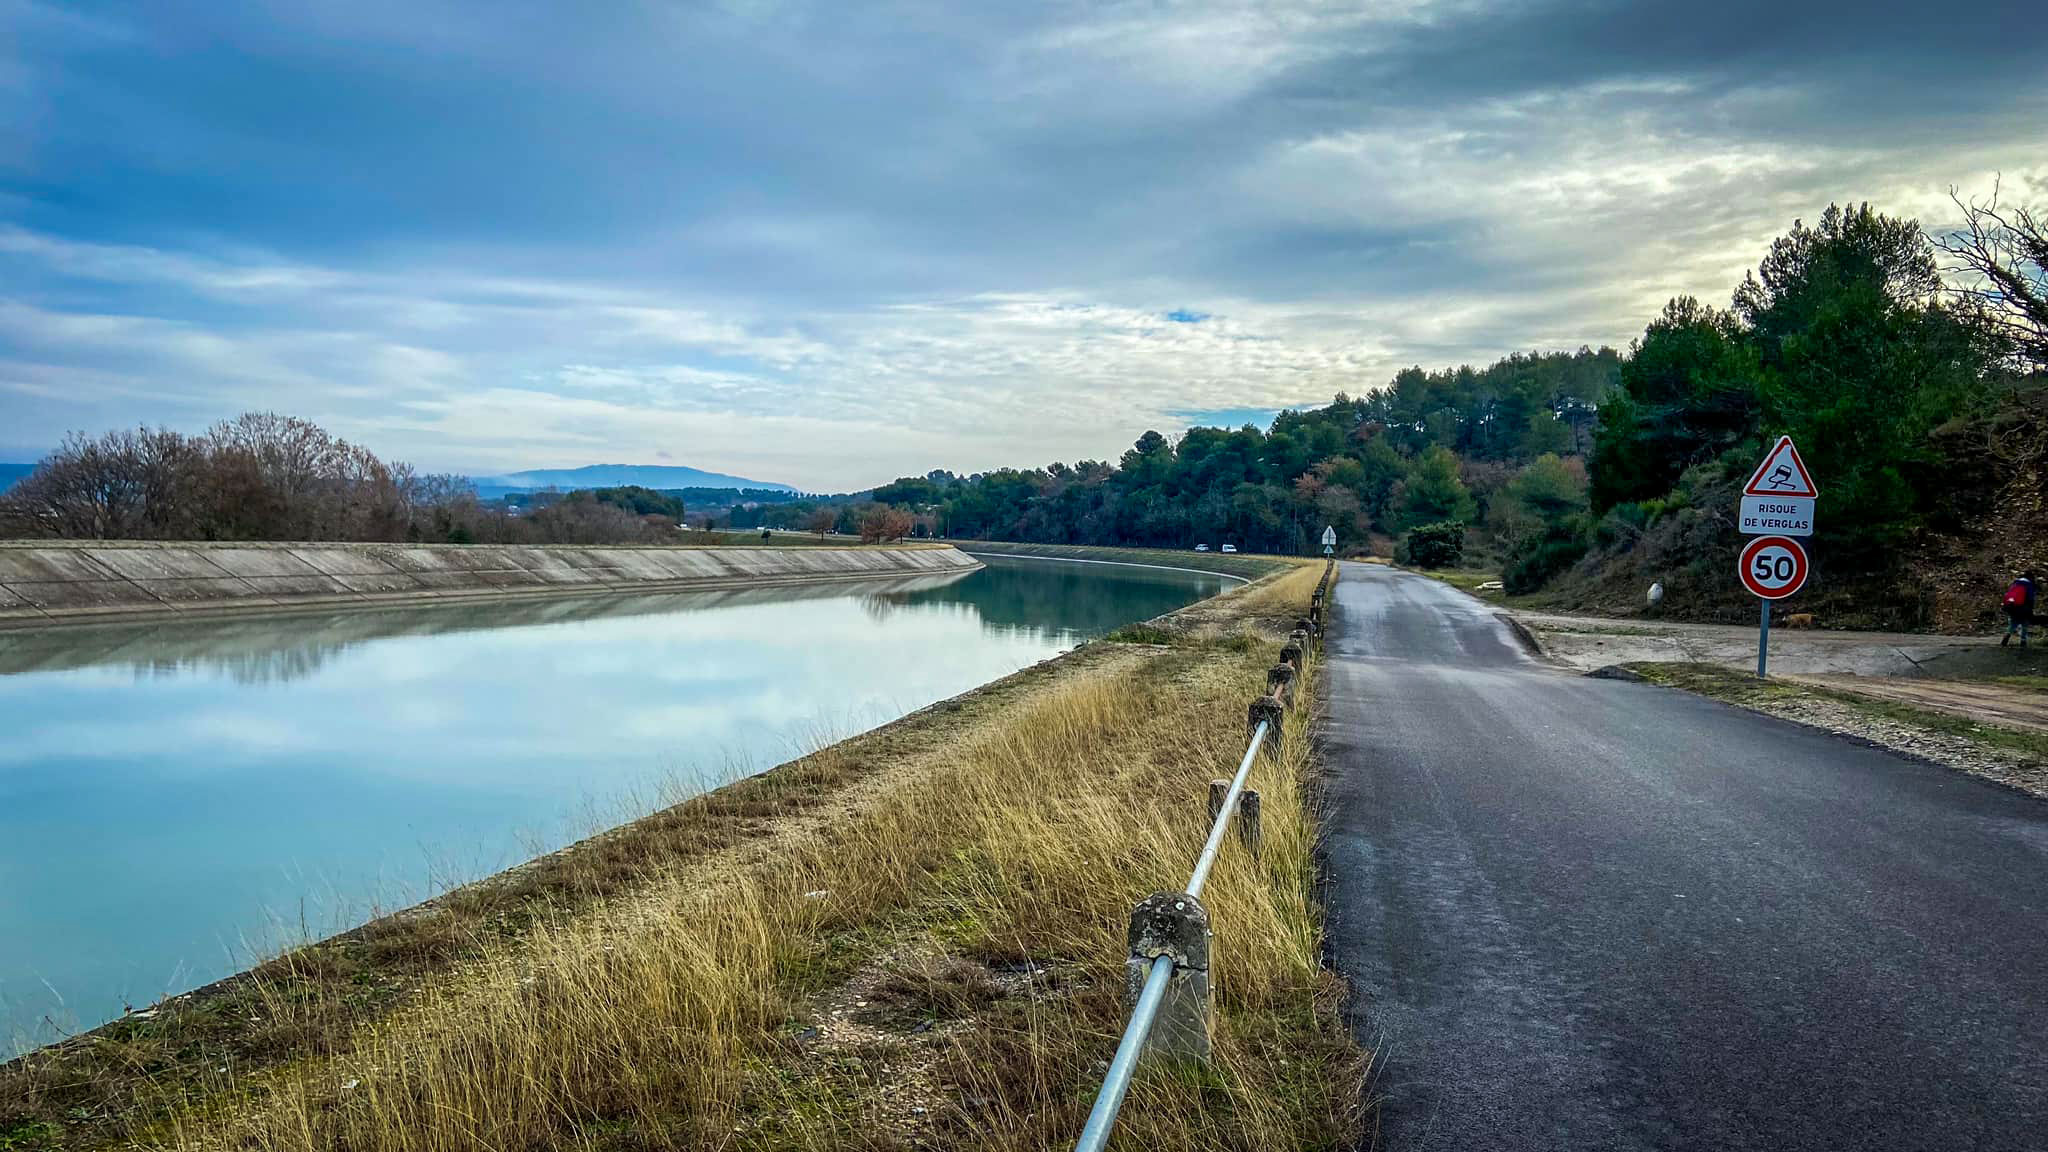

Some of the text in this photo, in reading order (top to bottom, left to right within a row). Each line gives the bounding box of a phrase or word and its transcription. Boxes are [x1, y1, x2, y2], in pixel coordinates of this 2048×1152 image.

[1758, 503, 1797, 514] RISQUE
[1744, 518, 1809, 529] DE VERGLAS
[1754, 555, 1794, 581] 50
